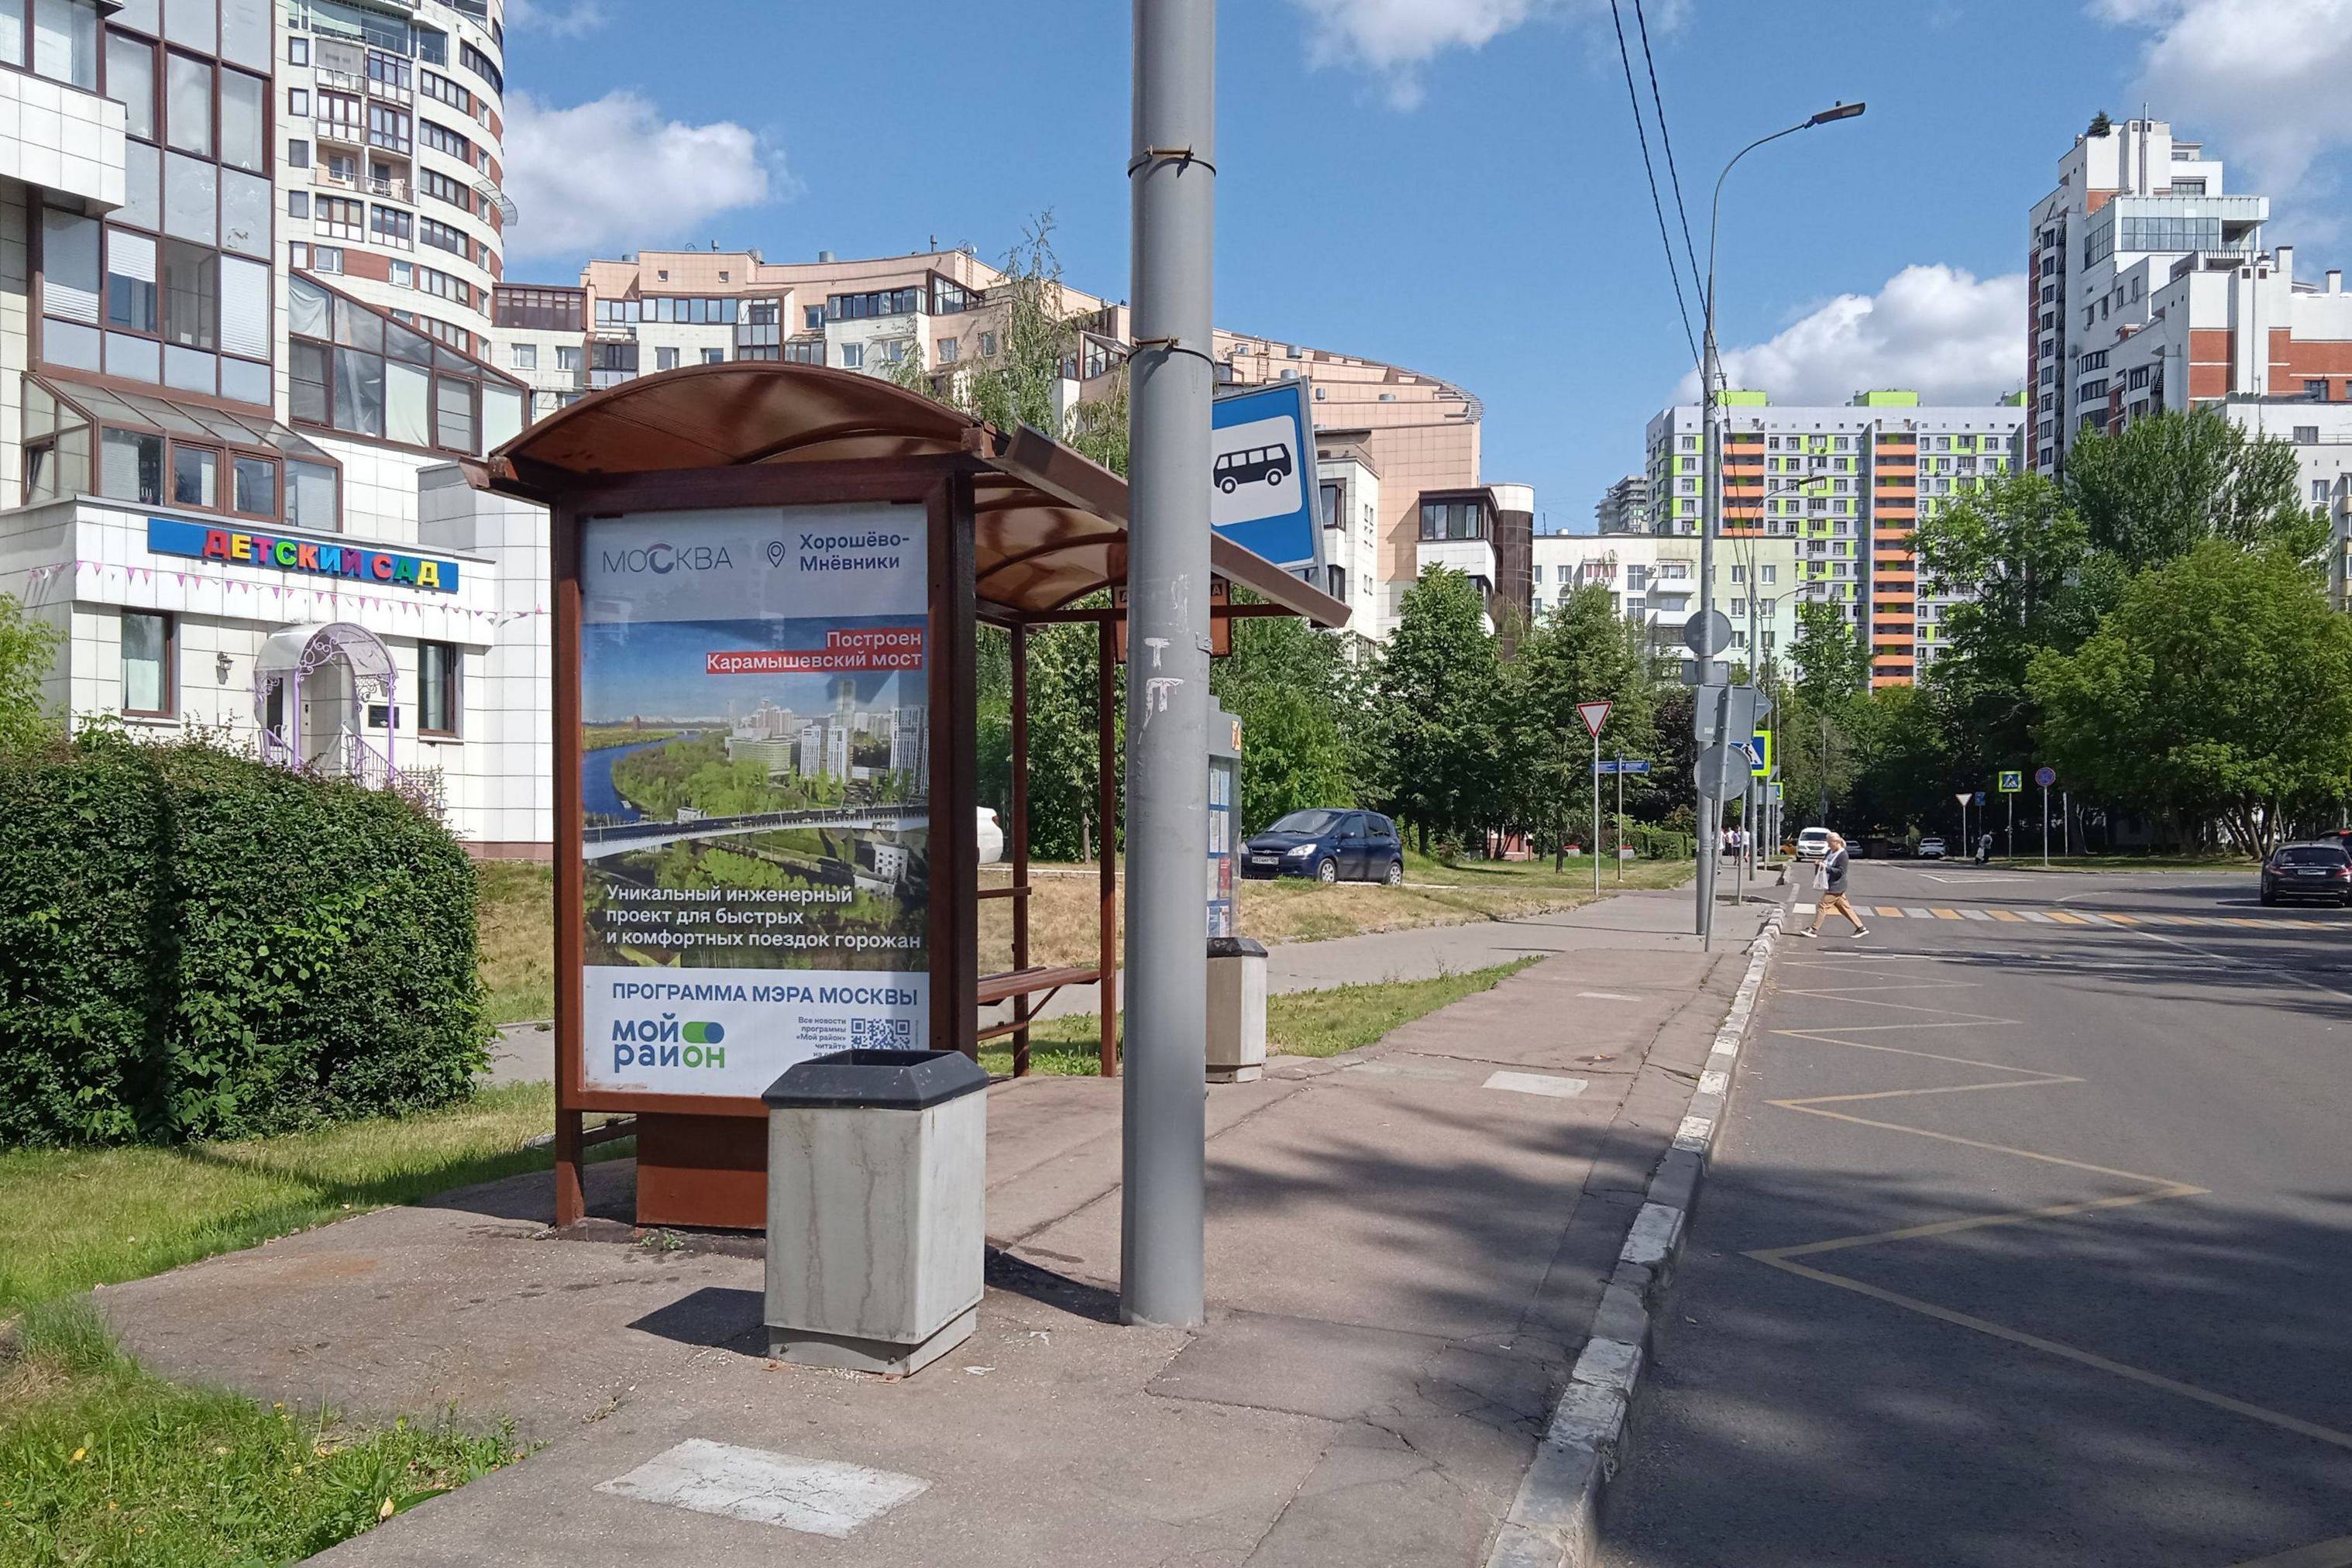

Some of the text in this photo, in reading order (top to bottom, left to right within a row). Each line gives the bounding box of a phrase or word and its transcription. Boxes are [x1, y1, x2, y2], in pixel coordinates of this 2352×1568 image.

[799, 532, 910, 551] Хорошёво-
[203, 530, 440, 588] ДЕТСКИЙ САД
[602, 542, 733, 575] МОСКВА
[799, 555, 900, 572] Мнёвники
[827, 631, 922, 649] Построен
[707, 651, 923, 672] Карамышевский мост
[607, 884, 853, 906] Уникальный инженерный
[606, 908, 804, 926] проект для быстрых
[607, 929, 920, 951] и комфортных поездок горожан
[612, 983, 917, 1006] ПРОГРАММА МЭРА МОСКВЫ
[612, 1013, 679, 1043] мой
